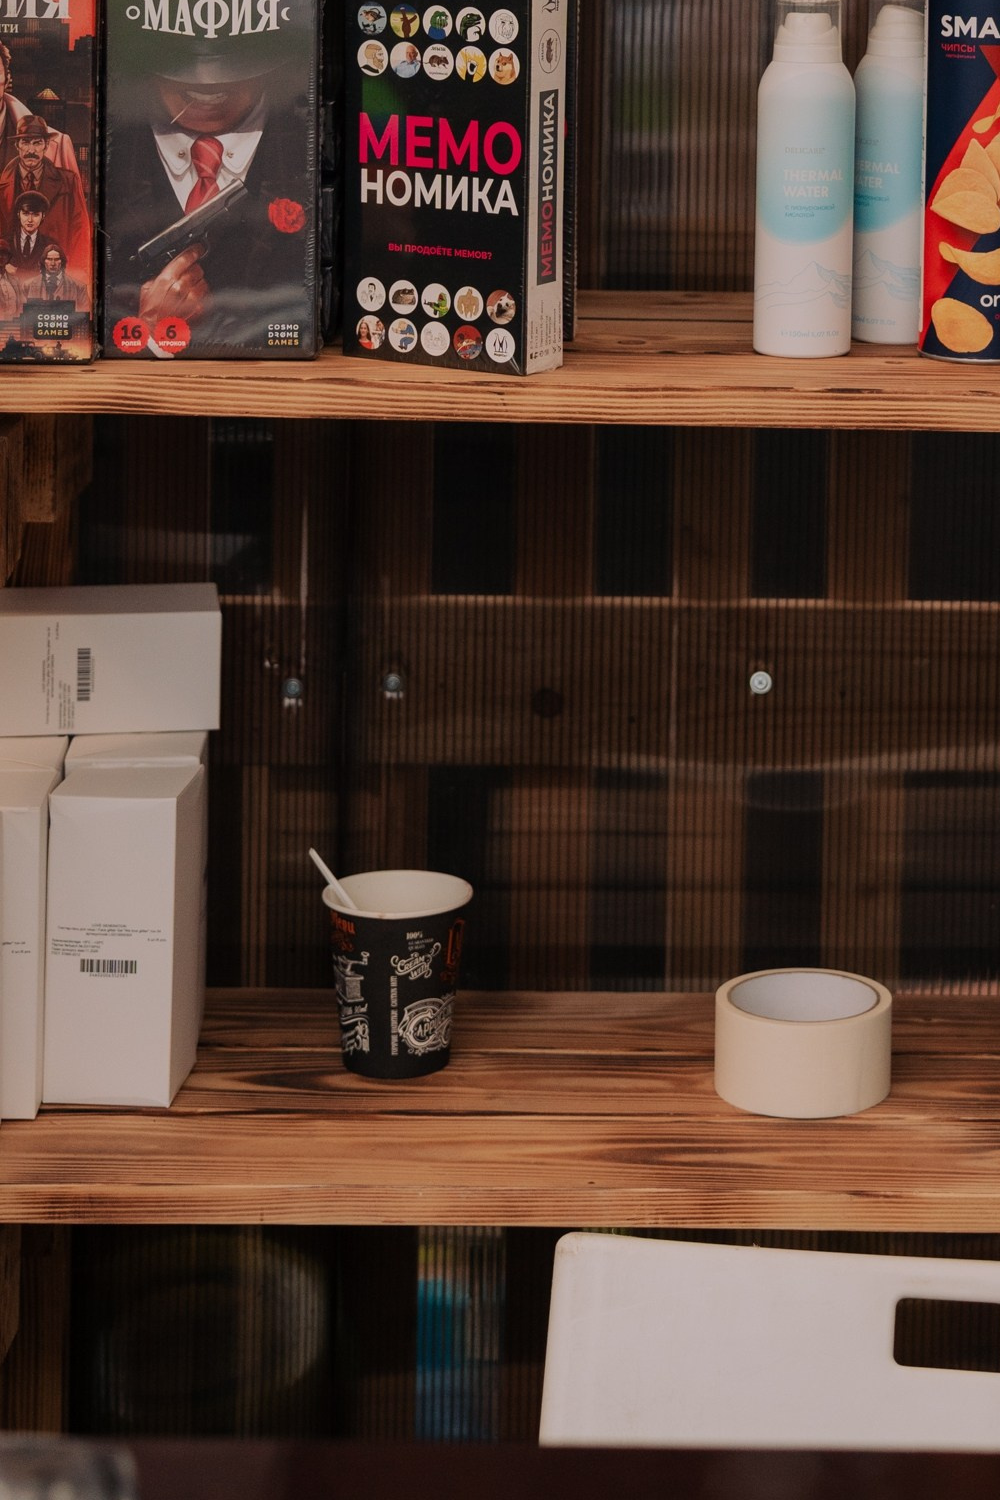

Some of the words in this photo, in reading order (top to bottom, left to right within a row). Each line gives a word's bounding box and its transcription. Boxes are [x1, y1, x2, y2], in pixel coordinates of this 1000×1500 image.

[940, 43, 976, 53] ЧИПСЫ
[359, 111, 522, 176] МЕМО
[783, 168, 844, 182] THERMAL
[540, 92, 556, 278] МЕМОНОМИКА
[854, 176, 884, 189] ATER
[360, 168, 519, 217] НОМИКА
[783, 185, 829, 198] WATER
[388, 242, 402, 251] ВЫ
[454, 248, 493, 260] МЕМОВ?
[37, 313, 69, 321] COSMO
[120, 324, 142, 340] 16
[165, 324, 177, 340] 6
[267, 323, 299, 331] COSMO
[121, 339, 142, 347] РОЛЕЙ
[267, 338, 299, 346] GAMES
